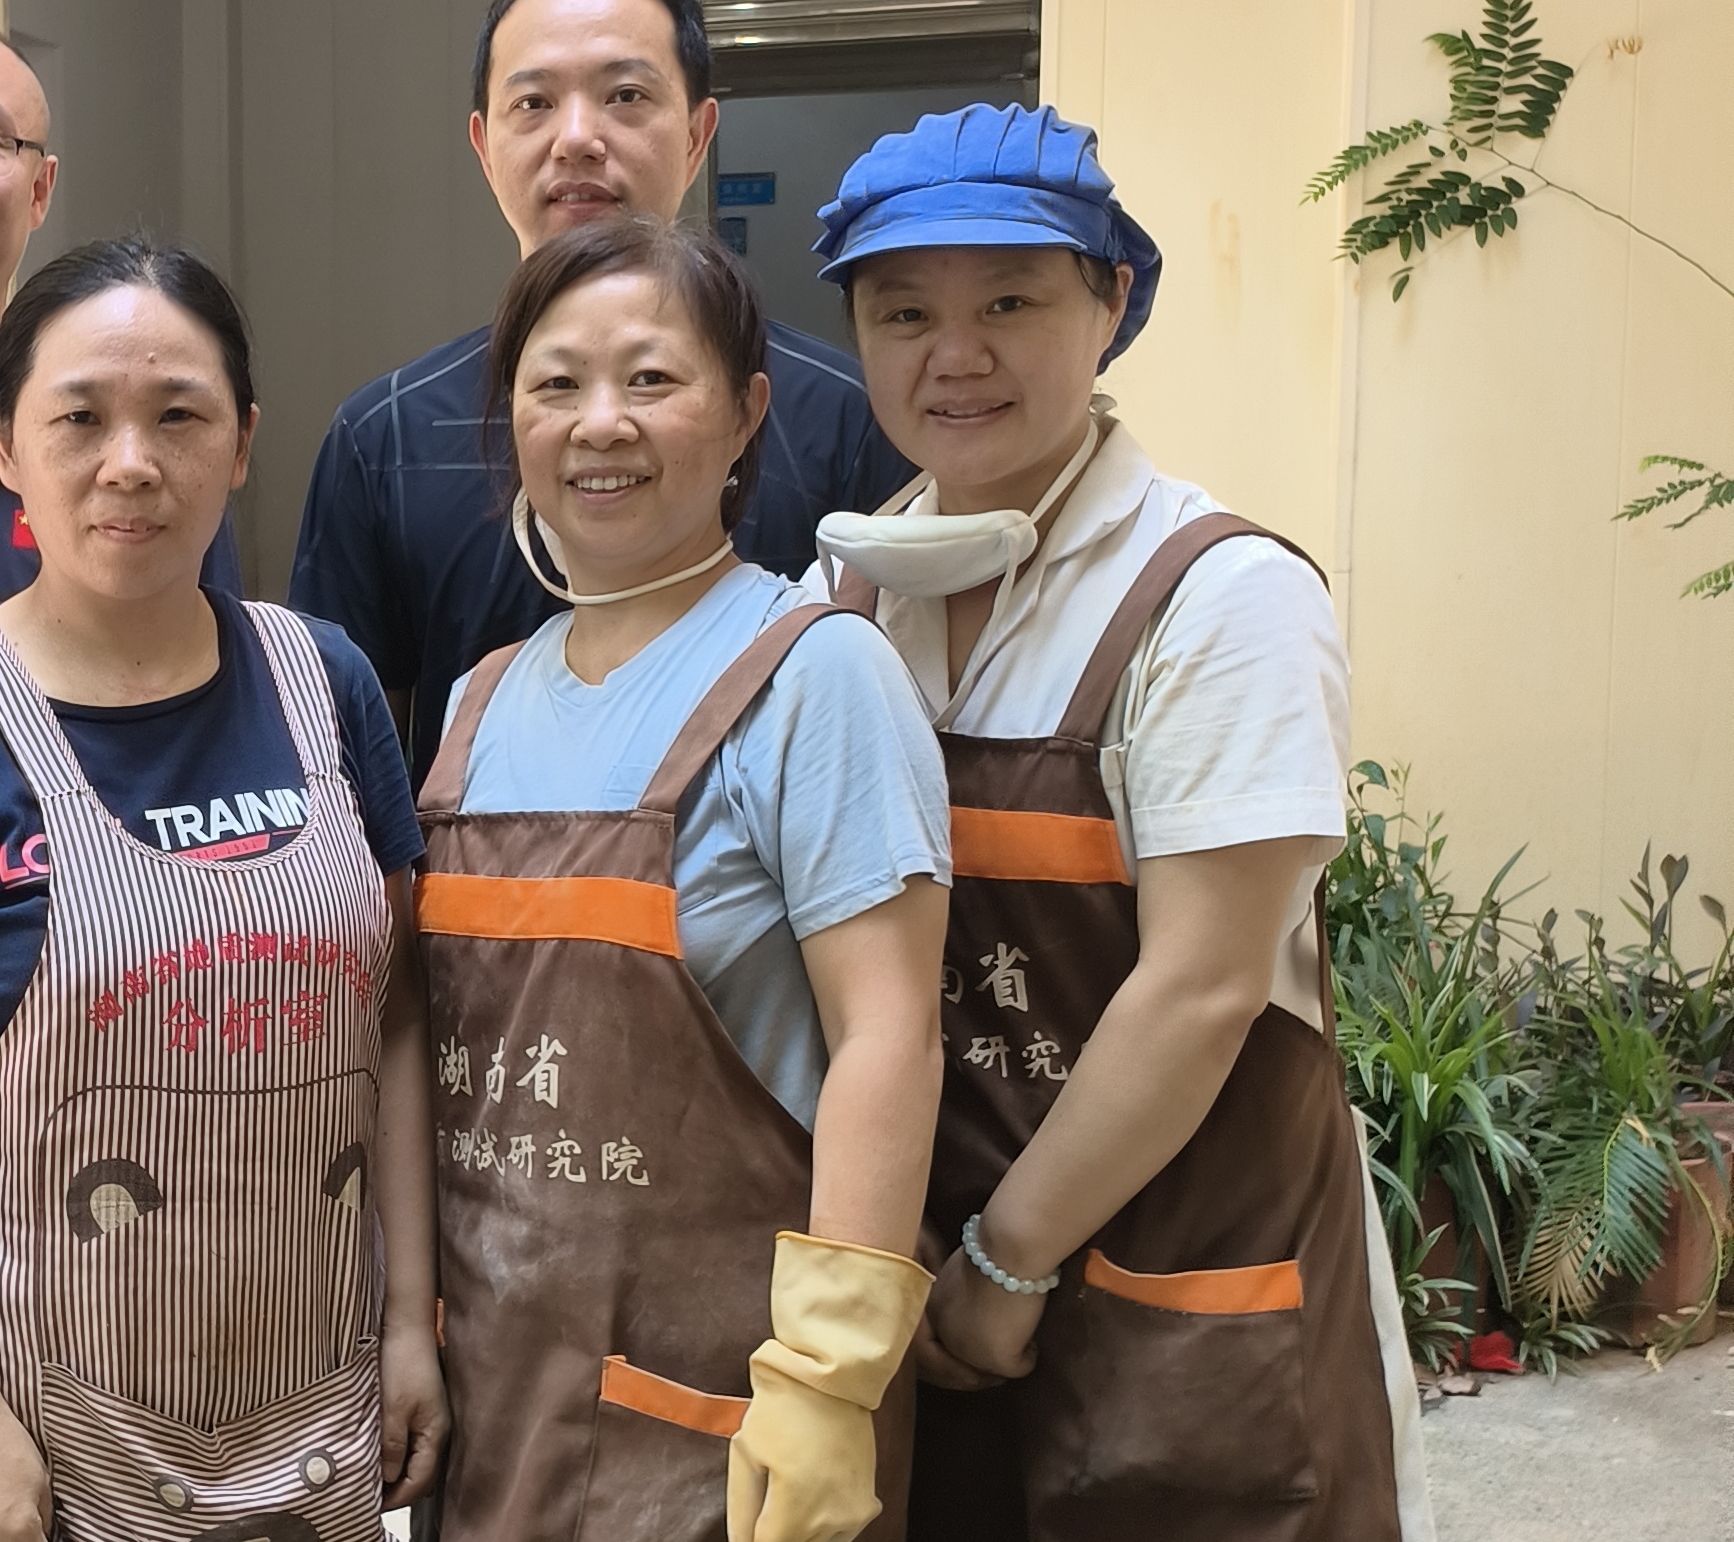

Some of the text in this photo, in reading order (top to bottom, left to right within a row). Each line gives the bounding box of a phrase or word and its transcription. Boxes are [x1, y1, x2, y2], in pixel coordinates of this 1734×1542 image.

[162, 990, 328, 1055] 分析室
[437, 1121, 650, 1186] 测试研究院
